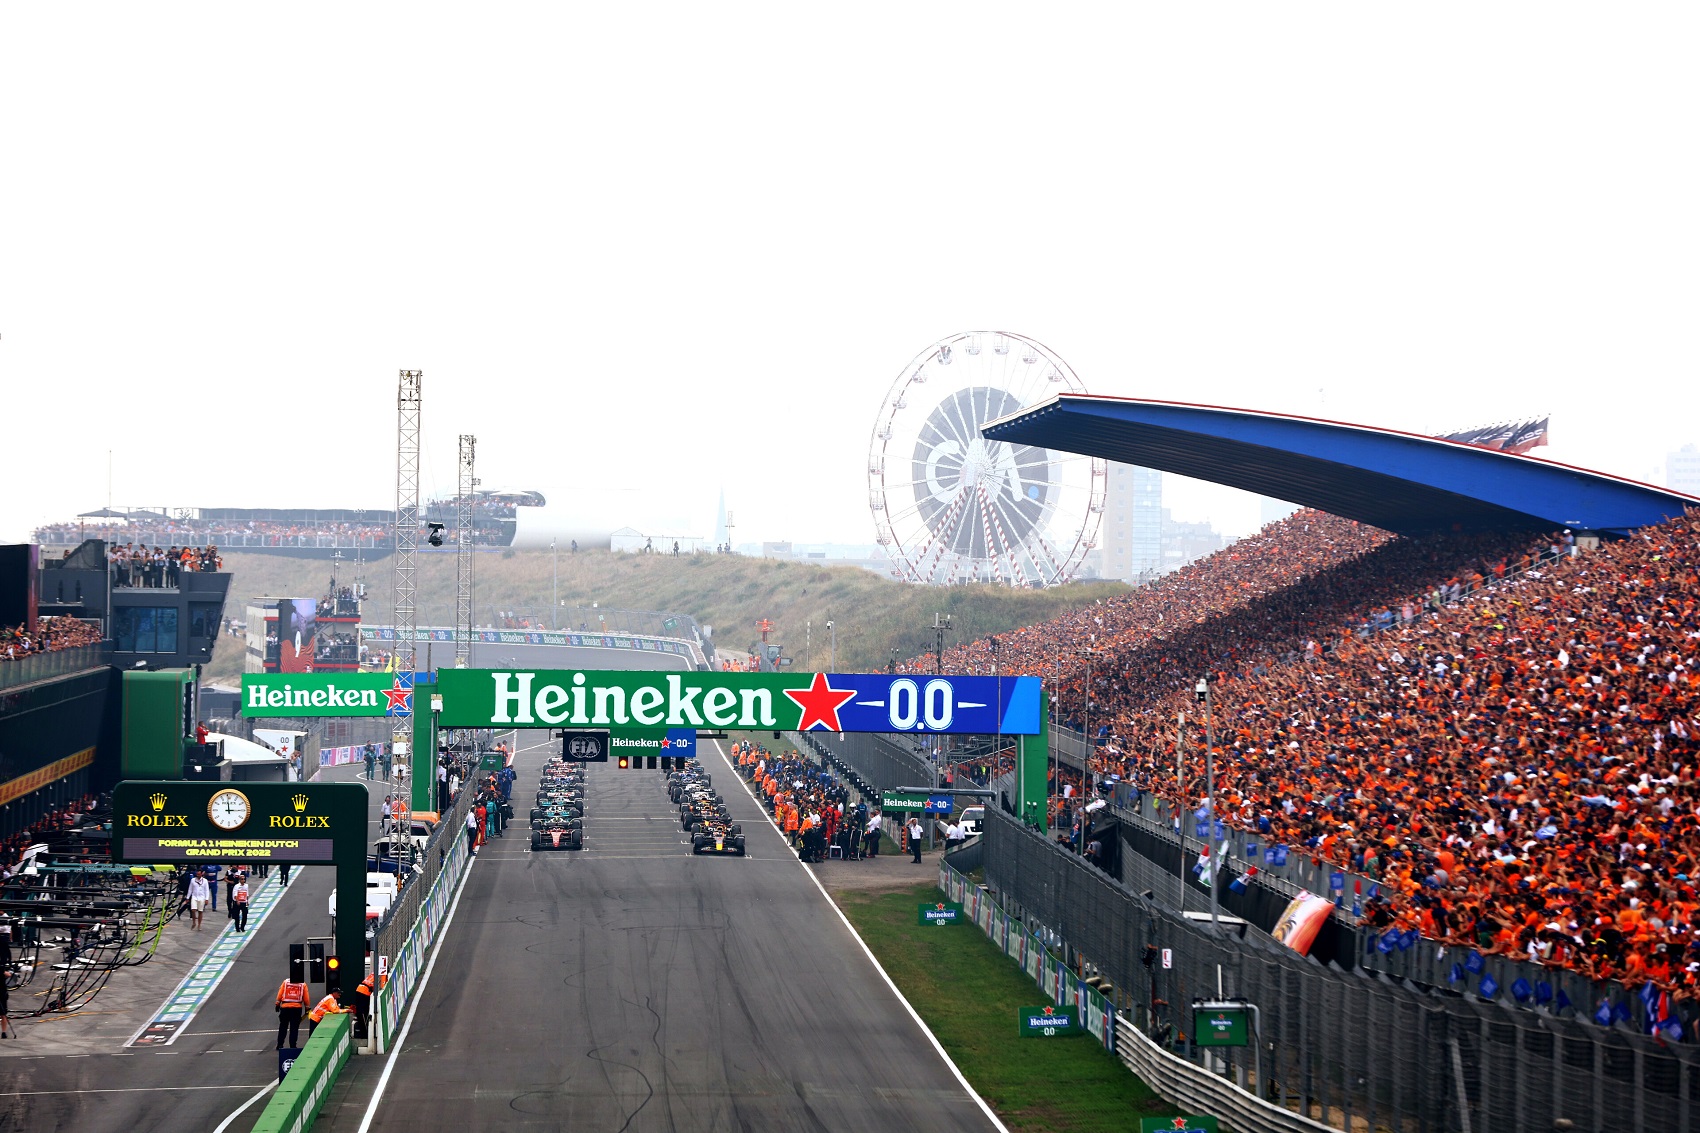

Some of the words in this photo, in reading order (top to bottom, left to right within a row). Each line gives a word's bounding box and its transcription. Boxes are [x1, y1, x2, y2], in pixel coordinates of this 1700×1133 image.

[247, 684, 378, 707] Heineken
[490, 672, 777, 726] Heineken
[889, 678, 954, 730] 0.0
[612, 738, 659, 748] Heineken
[883, 798, 923, 807] Heineken
[127, 815, 188, 827] ROLEX
[269, 815, 330, 828] ROLEX
[215, 840, 265, 848] HEINEKEN
[1030, 1017, 1068, 1026] Heineken
